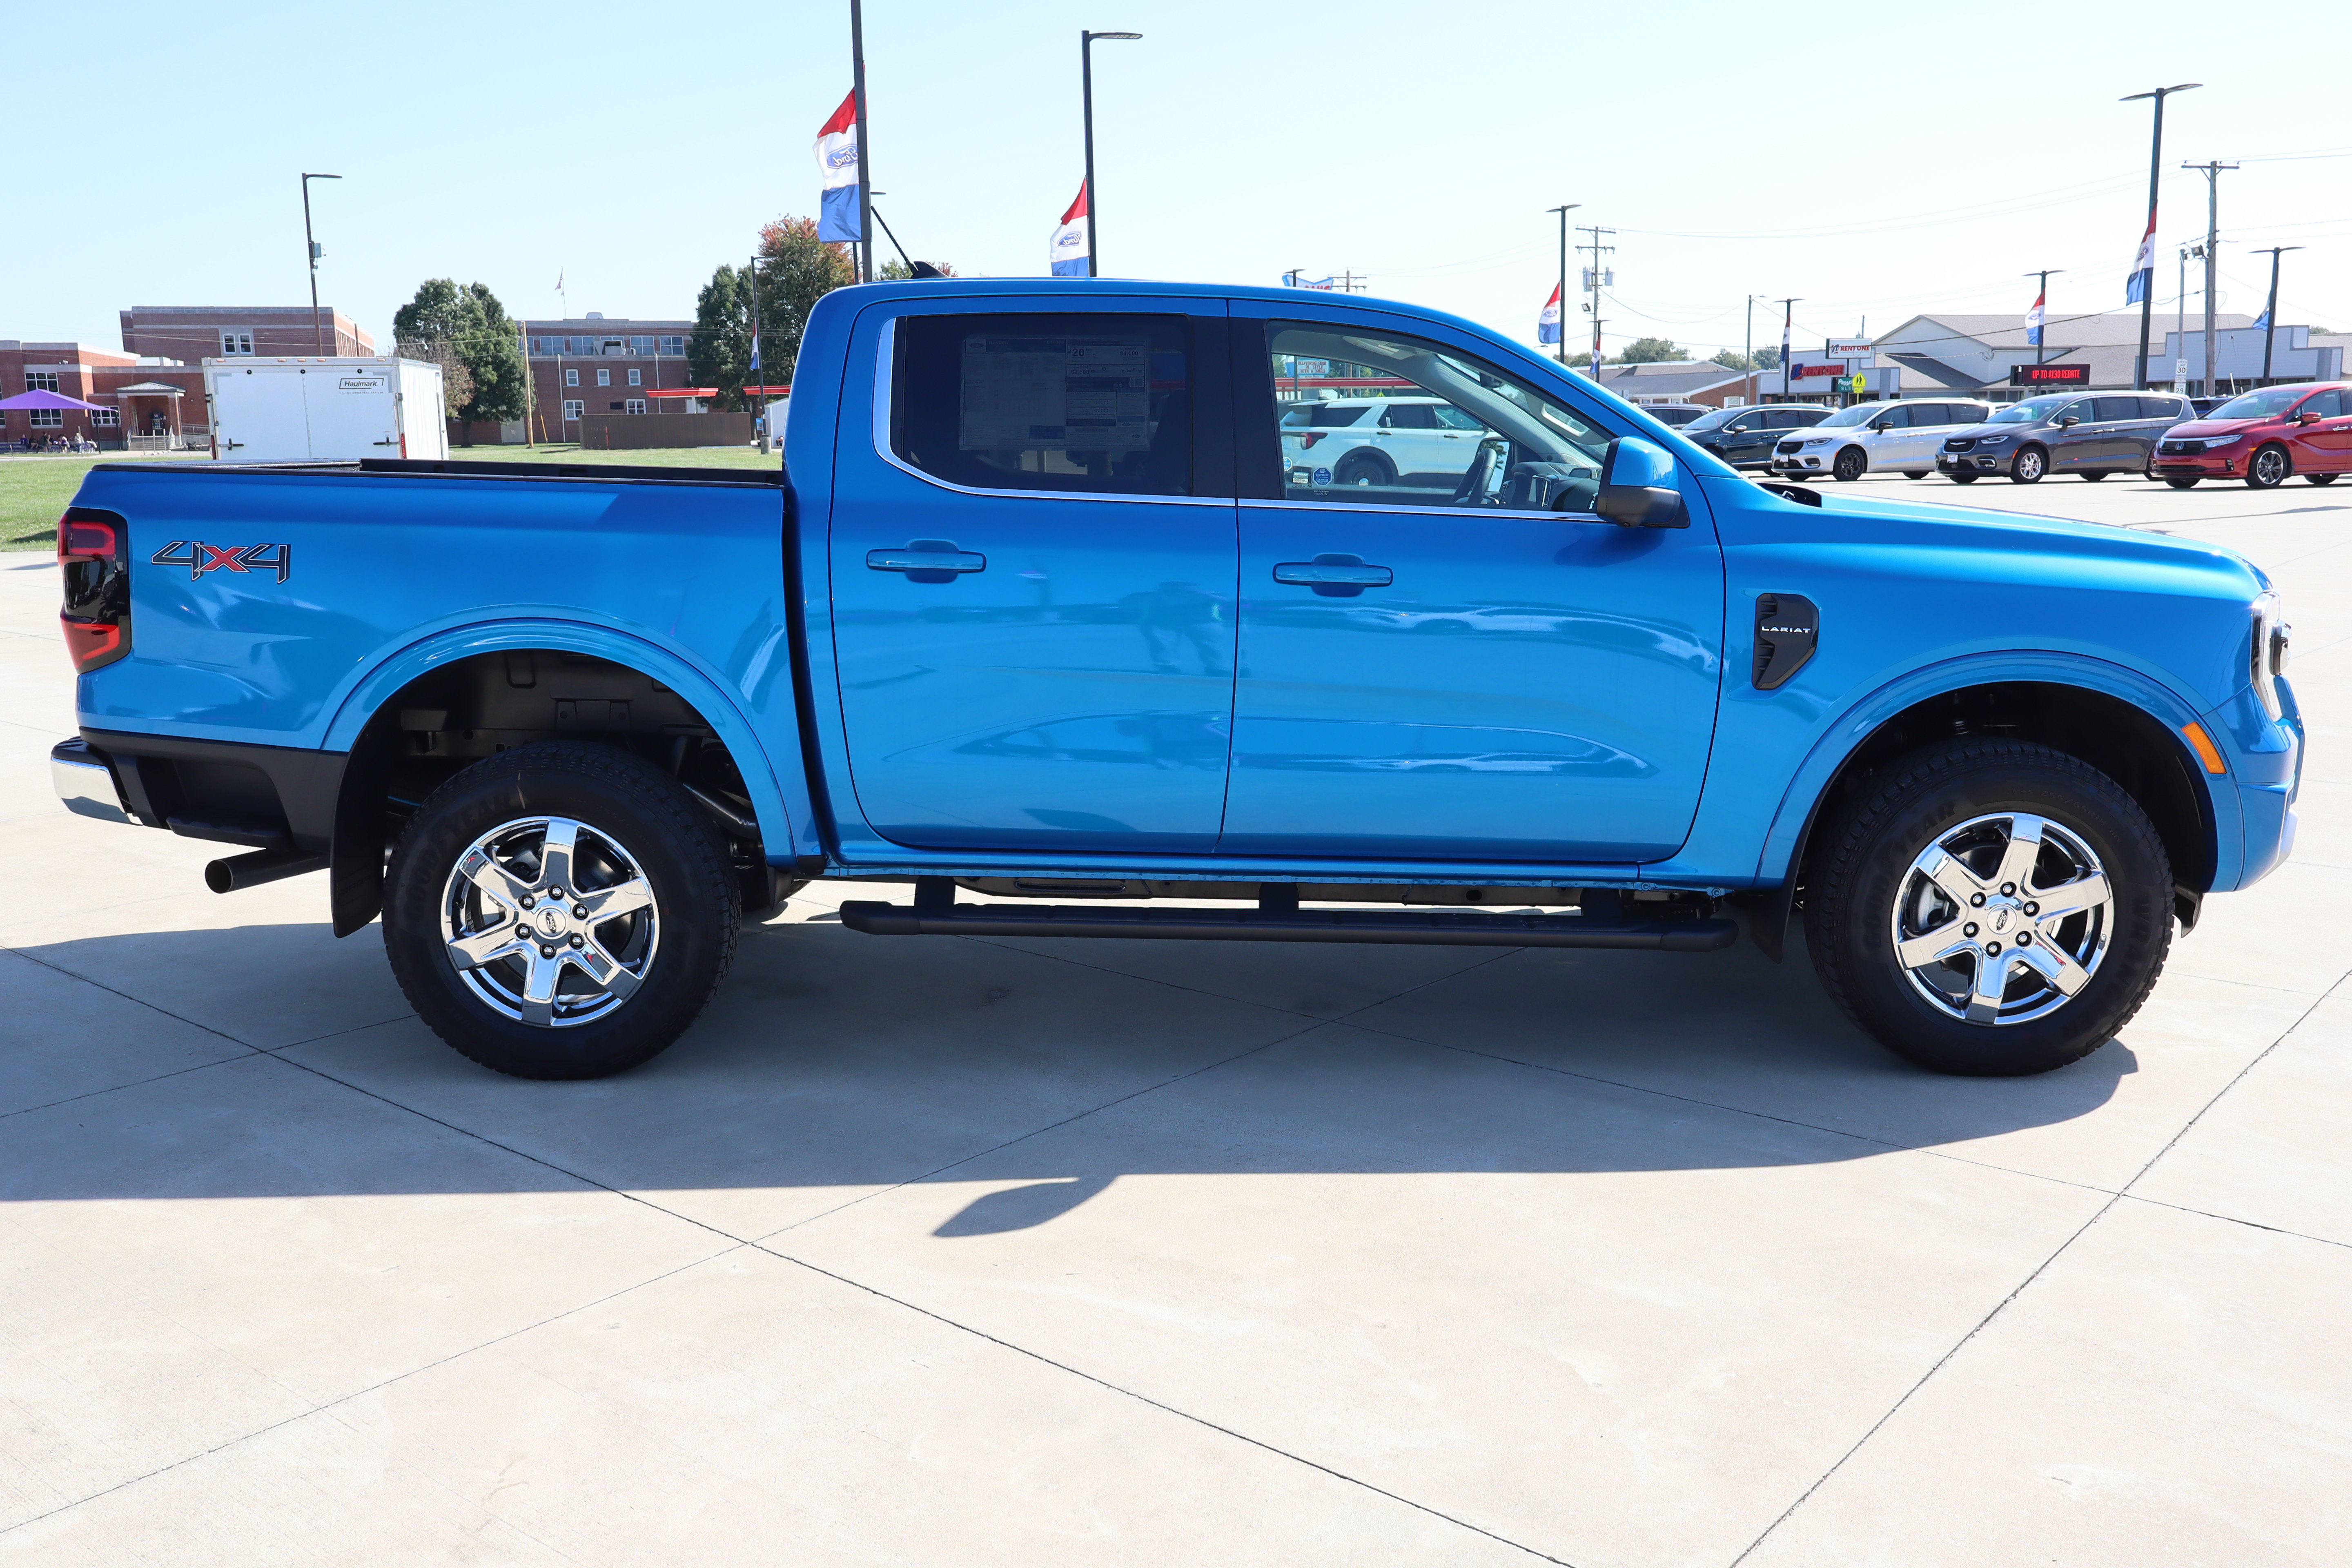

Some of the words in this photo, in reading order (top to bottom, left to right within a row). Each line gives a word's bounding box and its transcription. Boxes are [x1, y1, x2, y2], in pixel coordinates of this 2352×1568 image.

[1072, 348, 1085, 356] 20
[1802, 366, 1824, 376] RENT
[1824, 365, 1844, 375] ONE
[2032, 370, 2040, 379] UP
[2040, 370, 2047, 379] TO
[2062, 369, 2080, 378] REBATE
[403, 791, 512, 922] GOODYEAR
[1862, 800, 1956, 951] GOODYEAR
[547, 915, 556, 930] Ford
[1997, 912, 2007, 928] Ford
[2058, 893, 2151, 1042] WRANGLER
